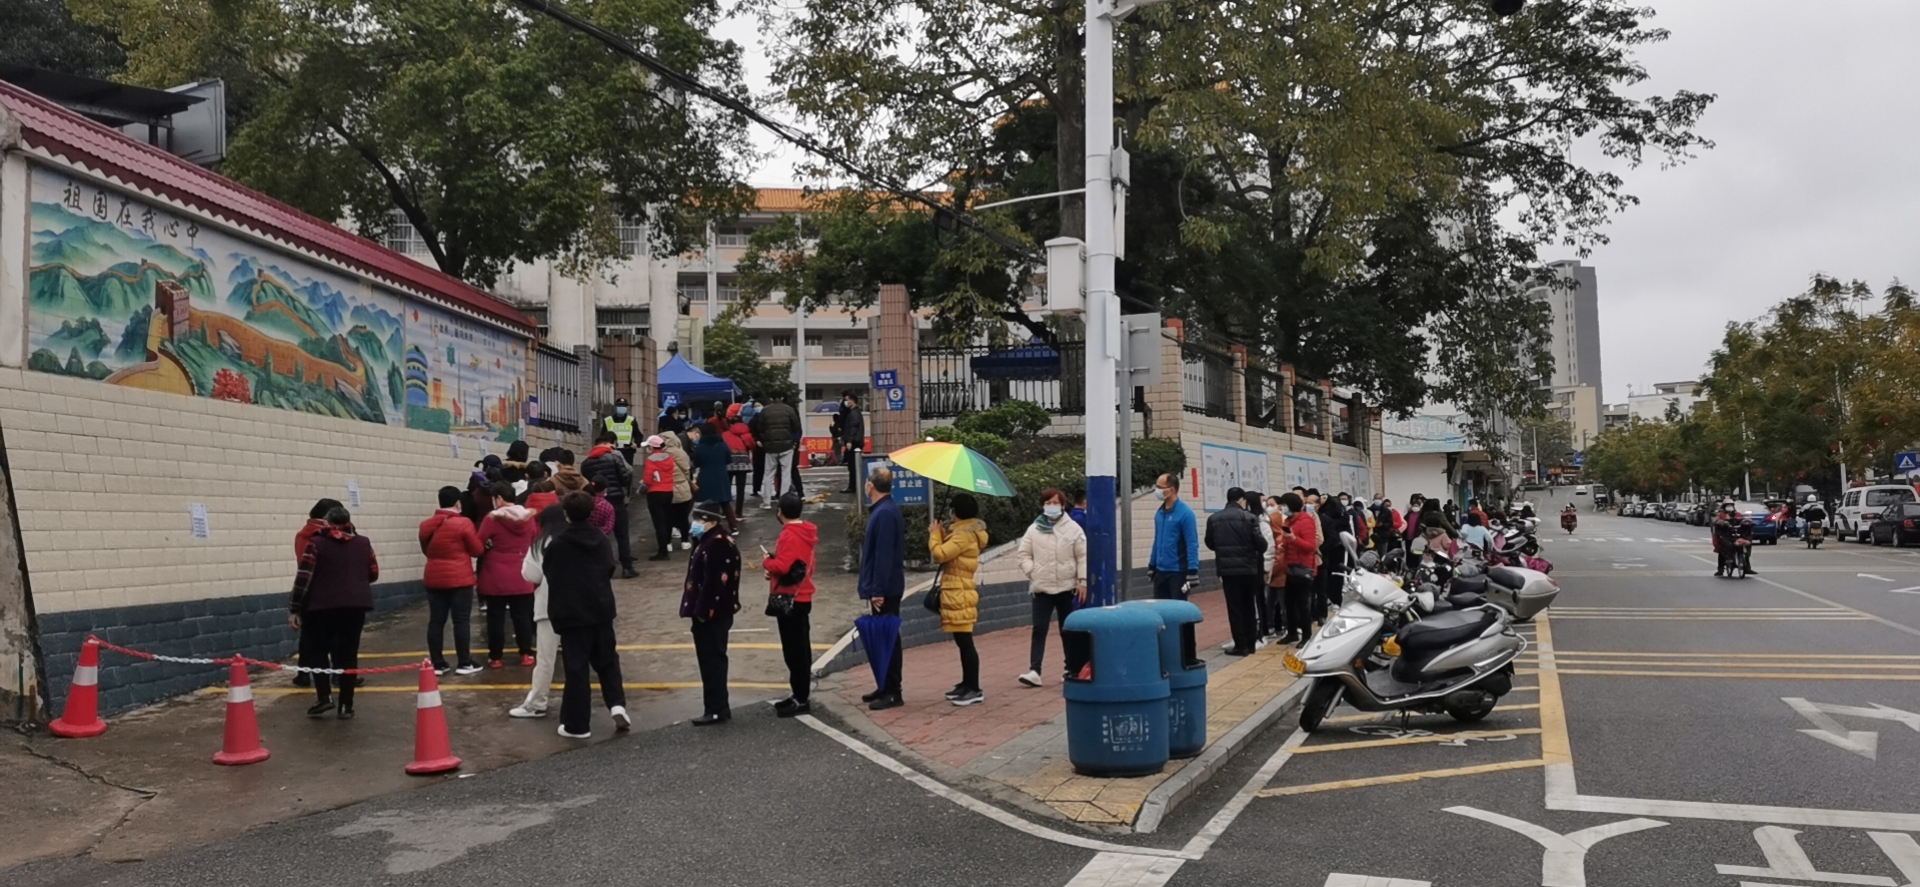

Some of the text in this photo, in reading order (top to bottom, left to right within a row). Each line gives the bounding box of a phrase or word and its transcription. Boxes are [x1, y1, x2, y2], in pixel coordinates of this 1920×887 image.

[63, 181, 199, 250] 祖国在我心中
[892, 390, 899, 398] 5
